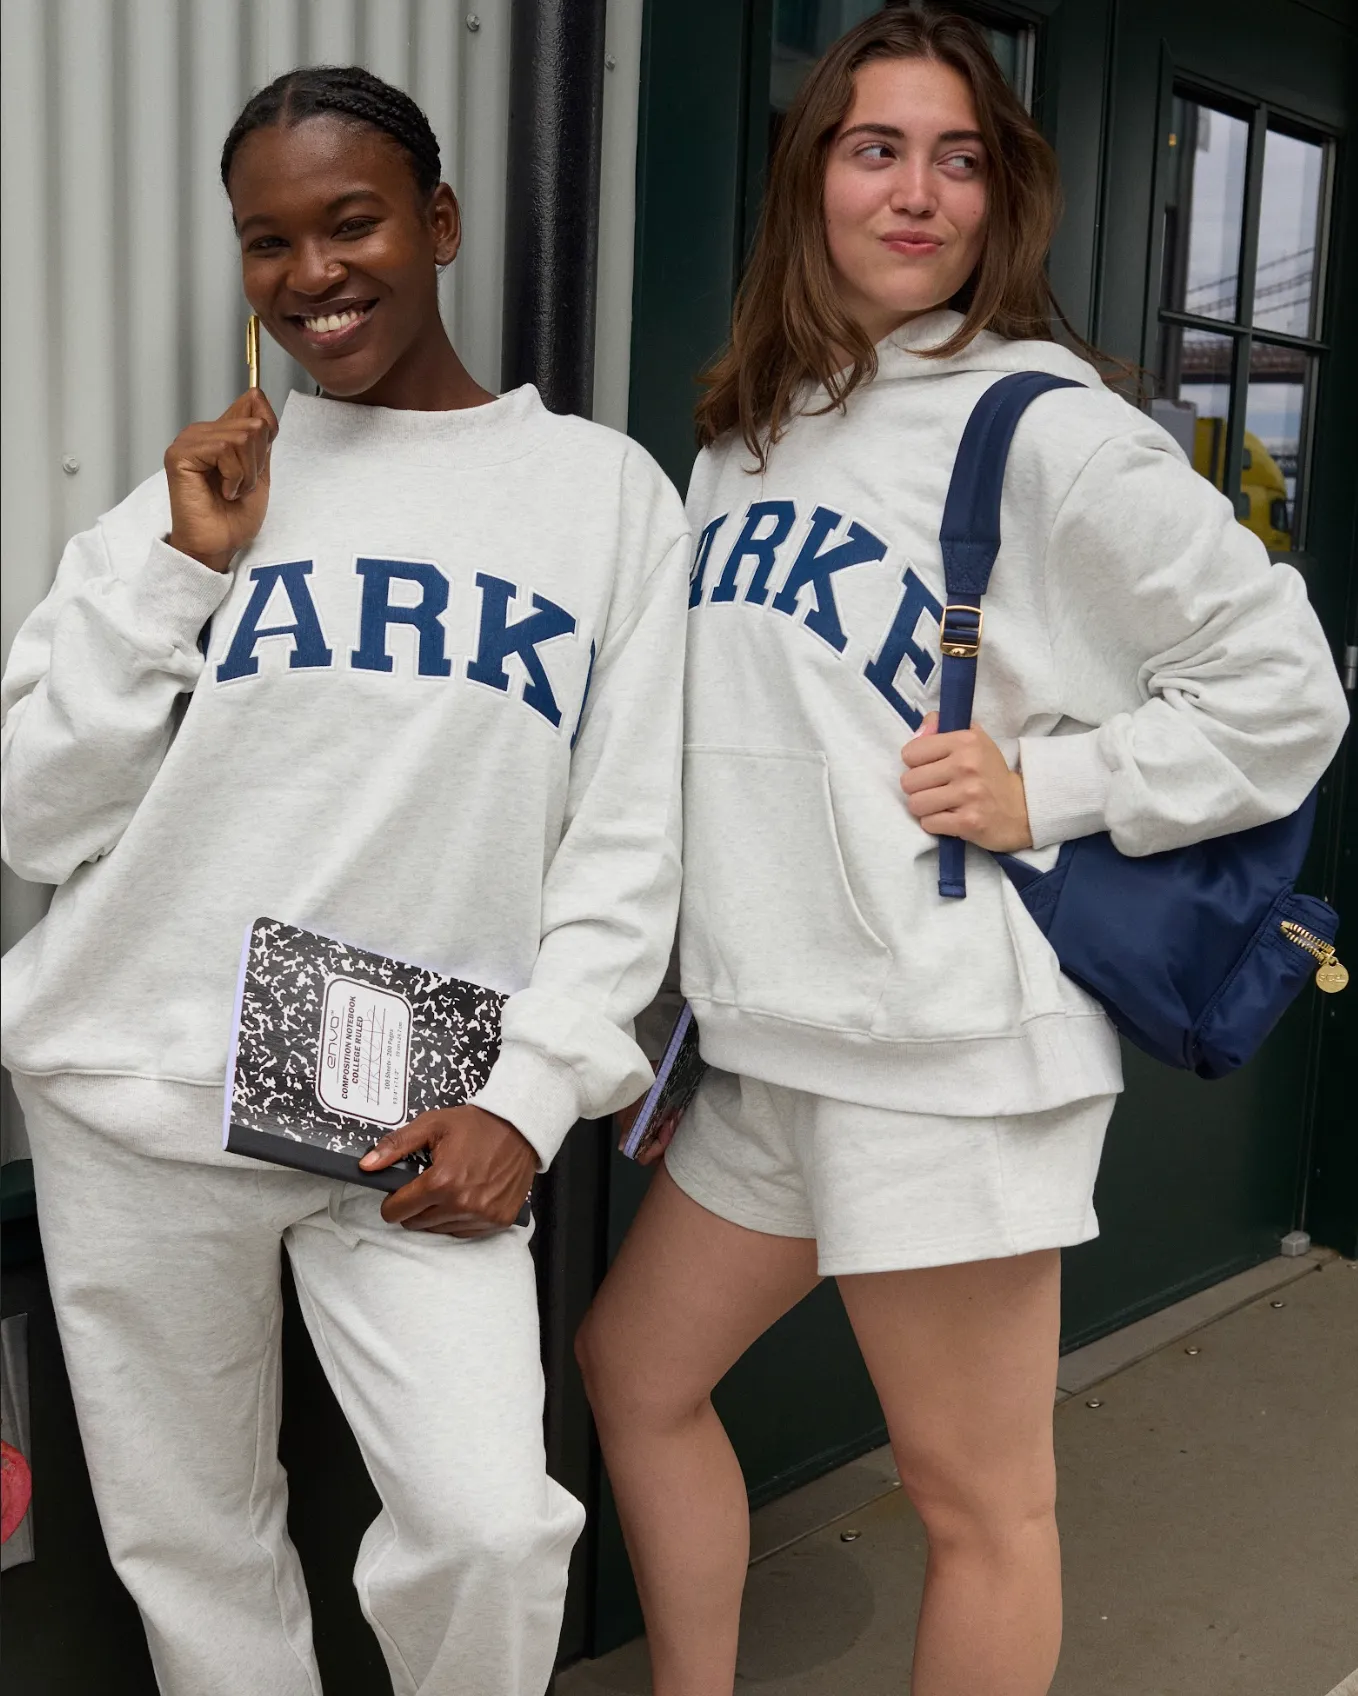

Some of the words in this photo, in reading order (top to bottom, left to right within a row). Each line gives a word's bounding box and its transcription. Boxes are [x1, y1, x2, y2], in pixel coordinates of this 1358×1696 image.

[200, 556, 596, 750] ARK
[345, 996, 357, 1041] NOTEBOOK
[355, 1016, 364, 1045] RULED
[341, 1042, 352, 1100] COMPOSITION
[351, 1046, 361, 1084] COLLEGE
